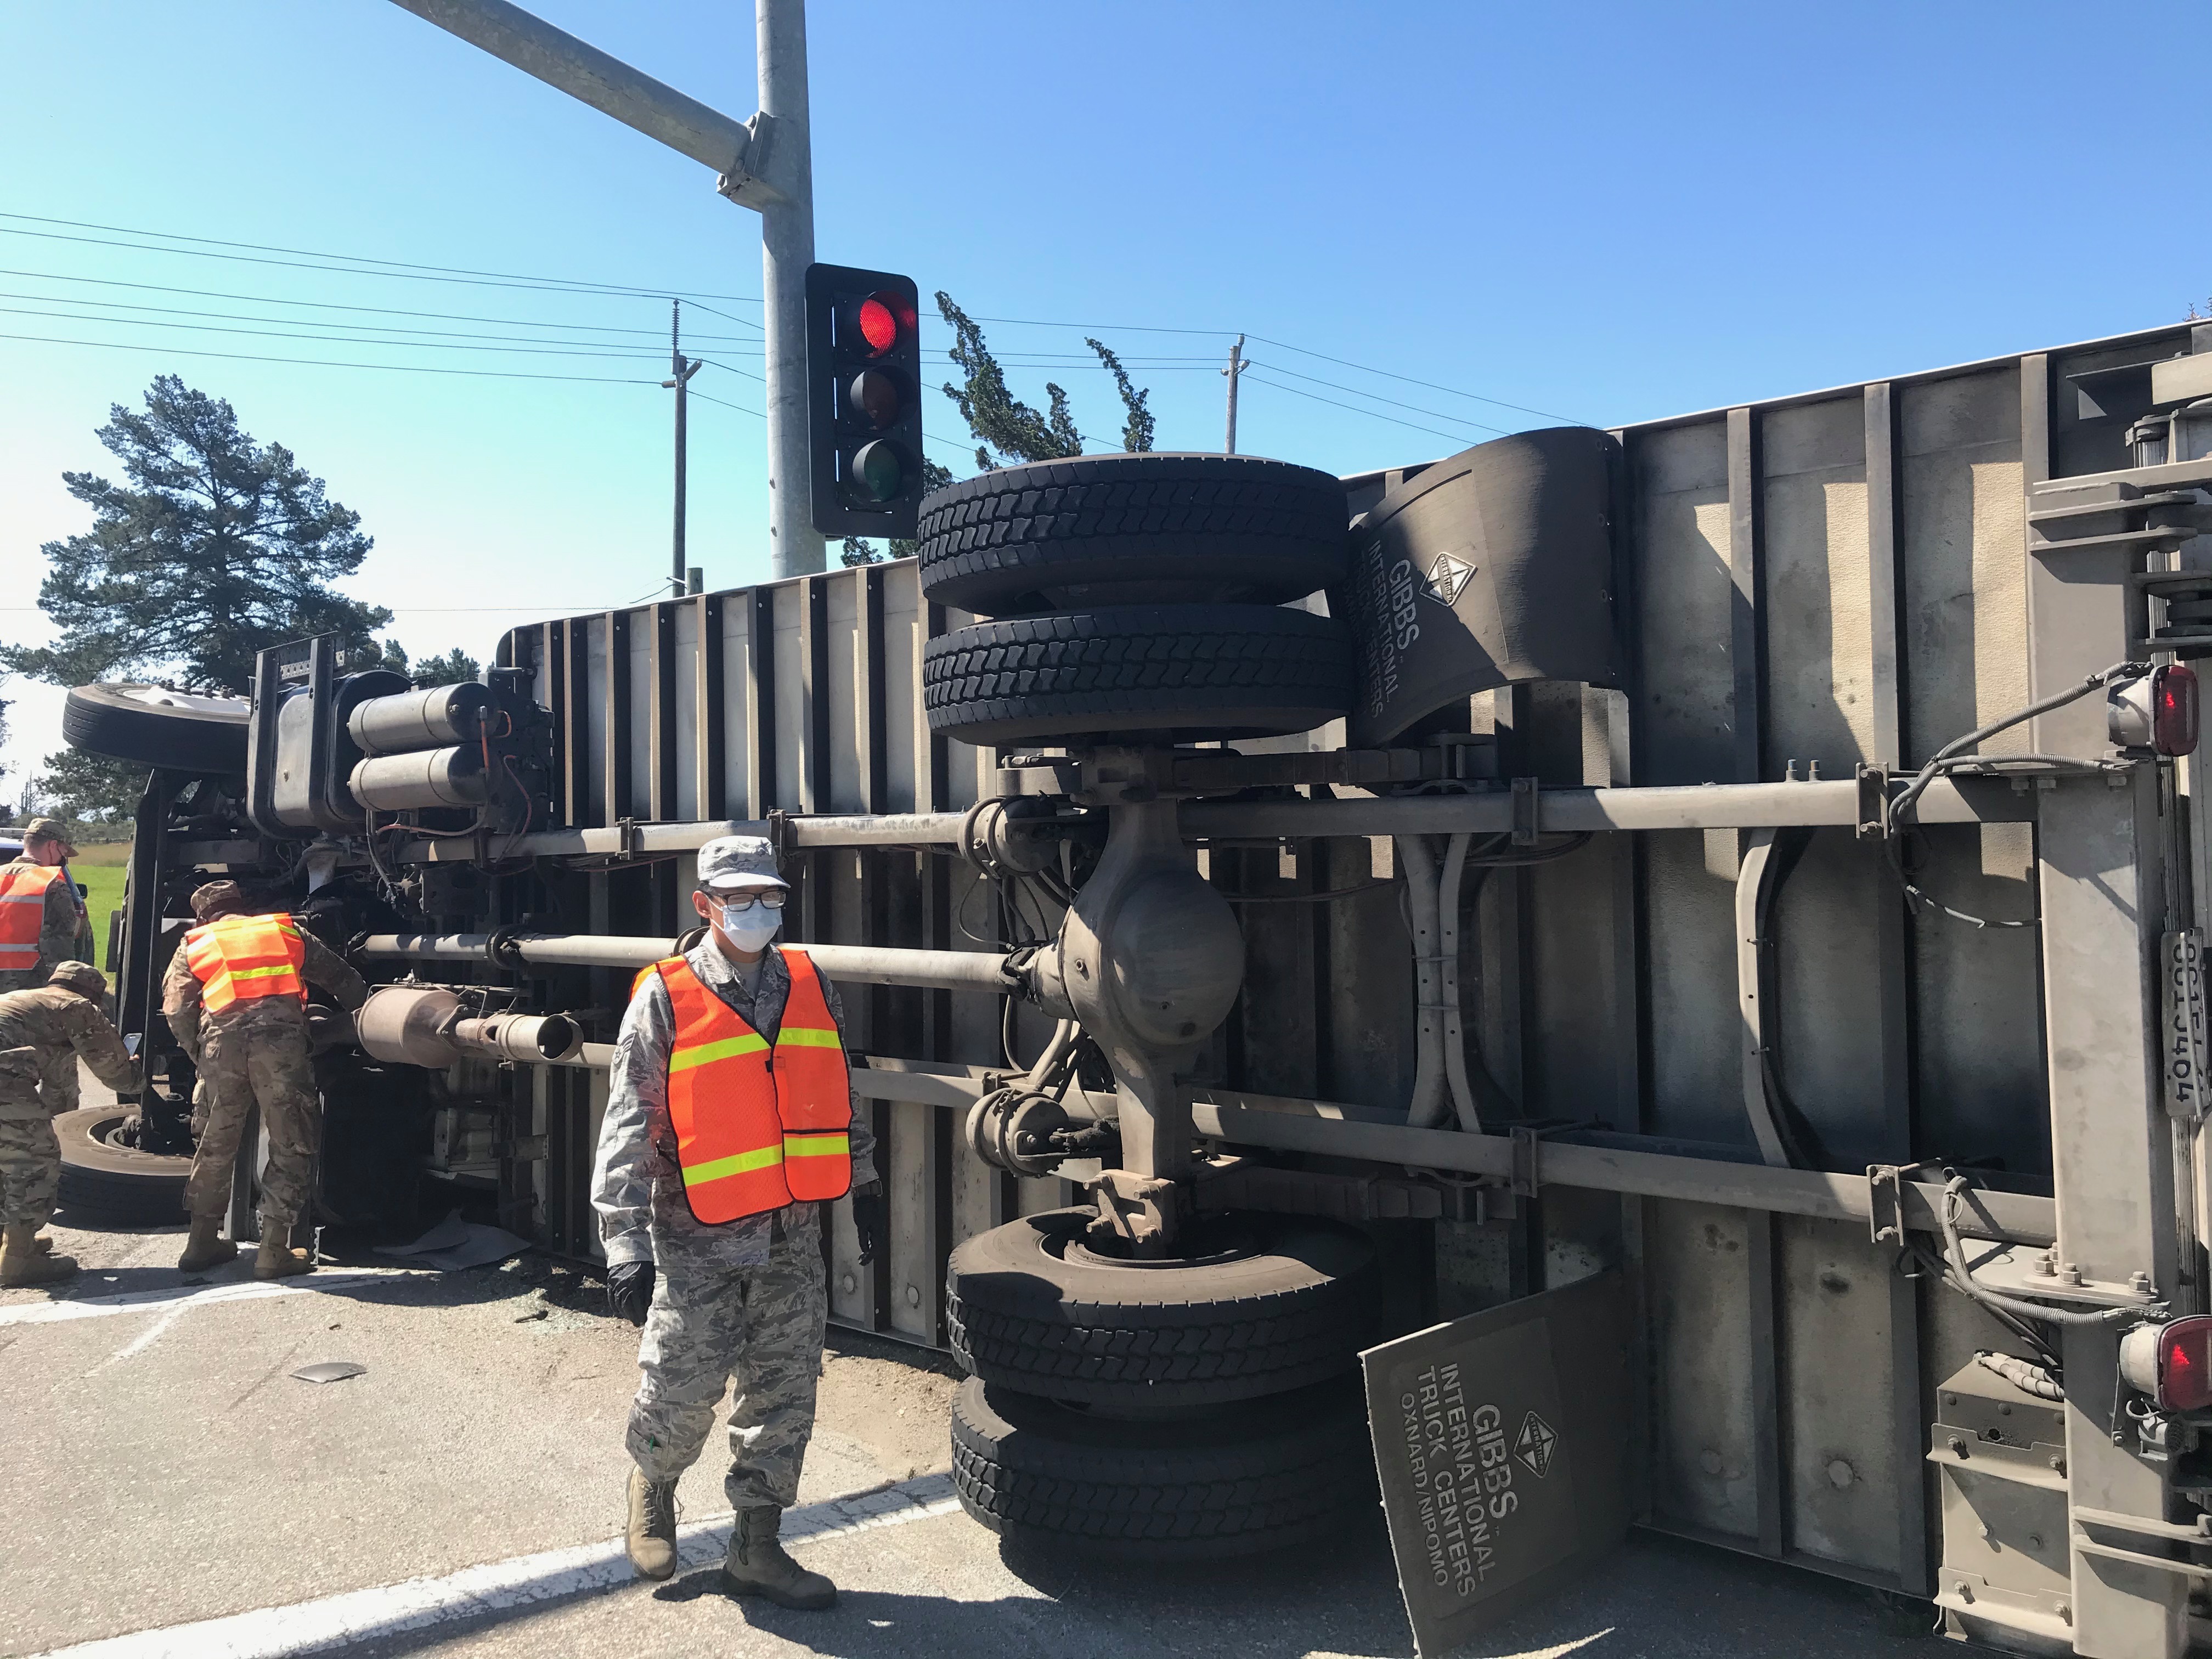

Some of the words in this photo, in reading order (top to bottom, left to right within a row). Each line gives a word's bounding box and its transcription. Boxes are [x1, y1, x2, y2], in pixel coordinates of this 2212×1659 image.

[1368, 540, 1398, 703] INTERNATIONAL
[1389, 559, 1420, 650] GIBBS
[1440, 554, 1453, 603] INTERNATIONAL
[1364, 628, 1383, 719] CENTERS
[1400, 1391, 1449, 1587] OXNARD/NIPOMO
[1418, 1365, 1448, 1459] TRUCK
[1434, 1470, 1476, 1598] CENTERS
[1440, 1363, 1496, 1582] INTERNATIONAL
[1472, 1404, 1518, 1519] GIBBS
